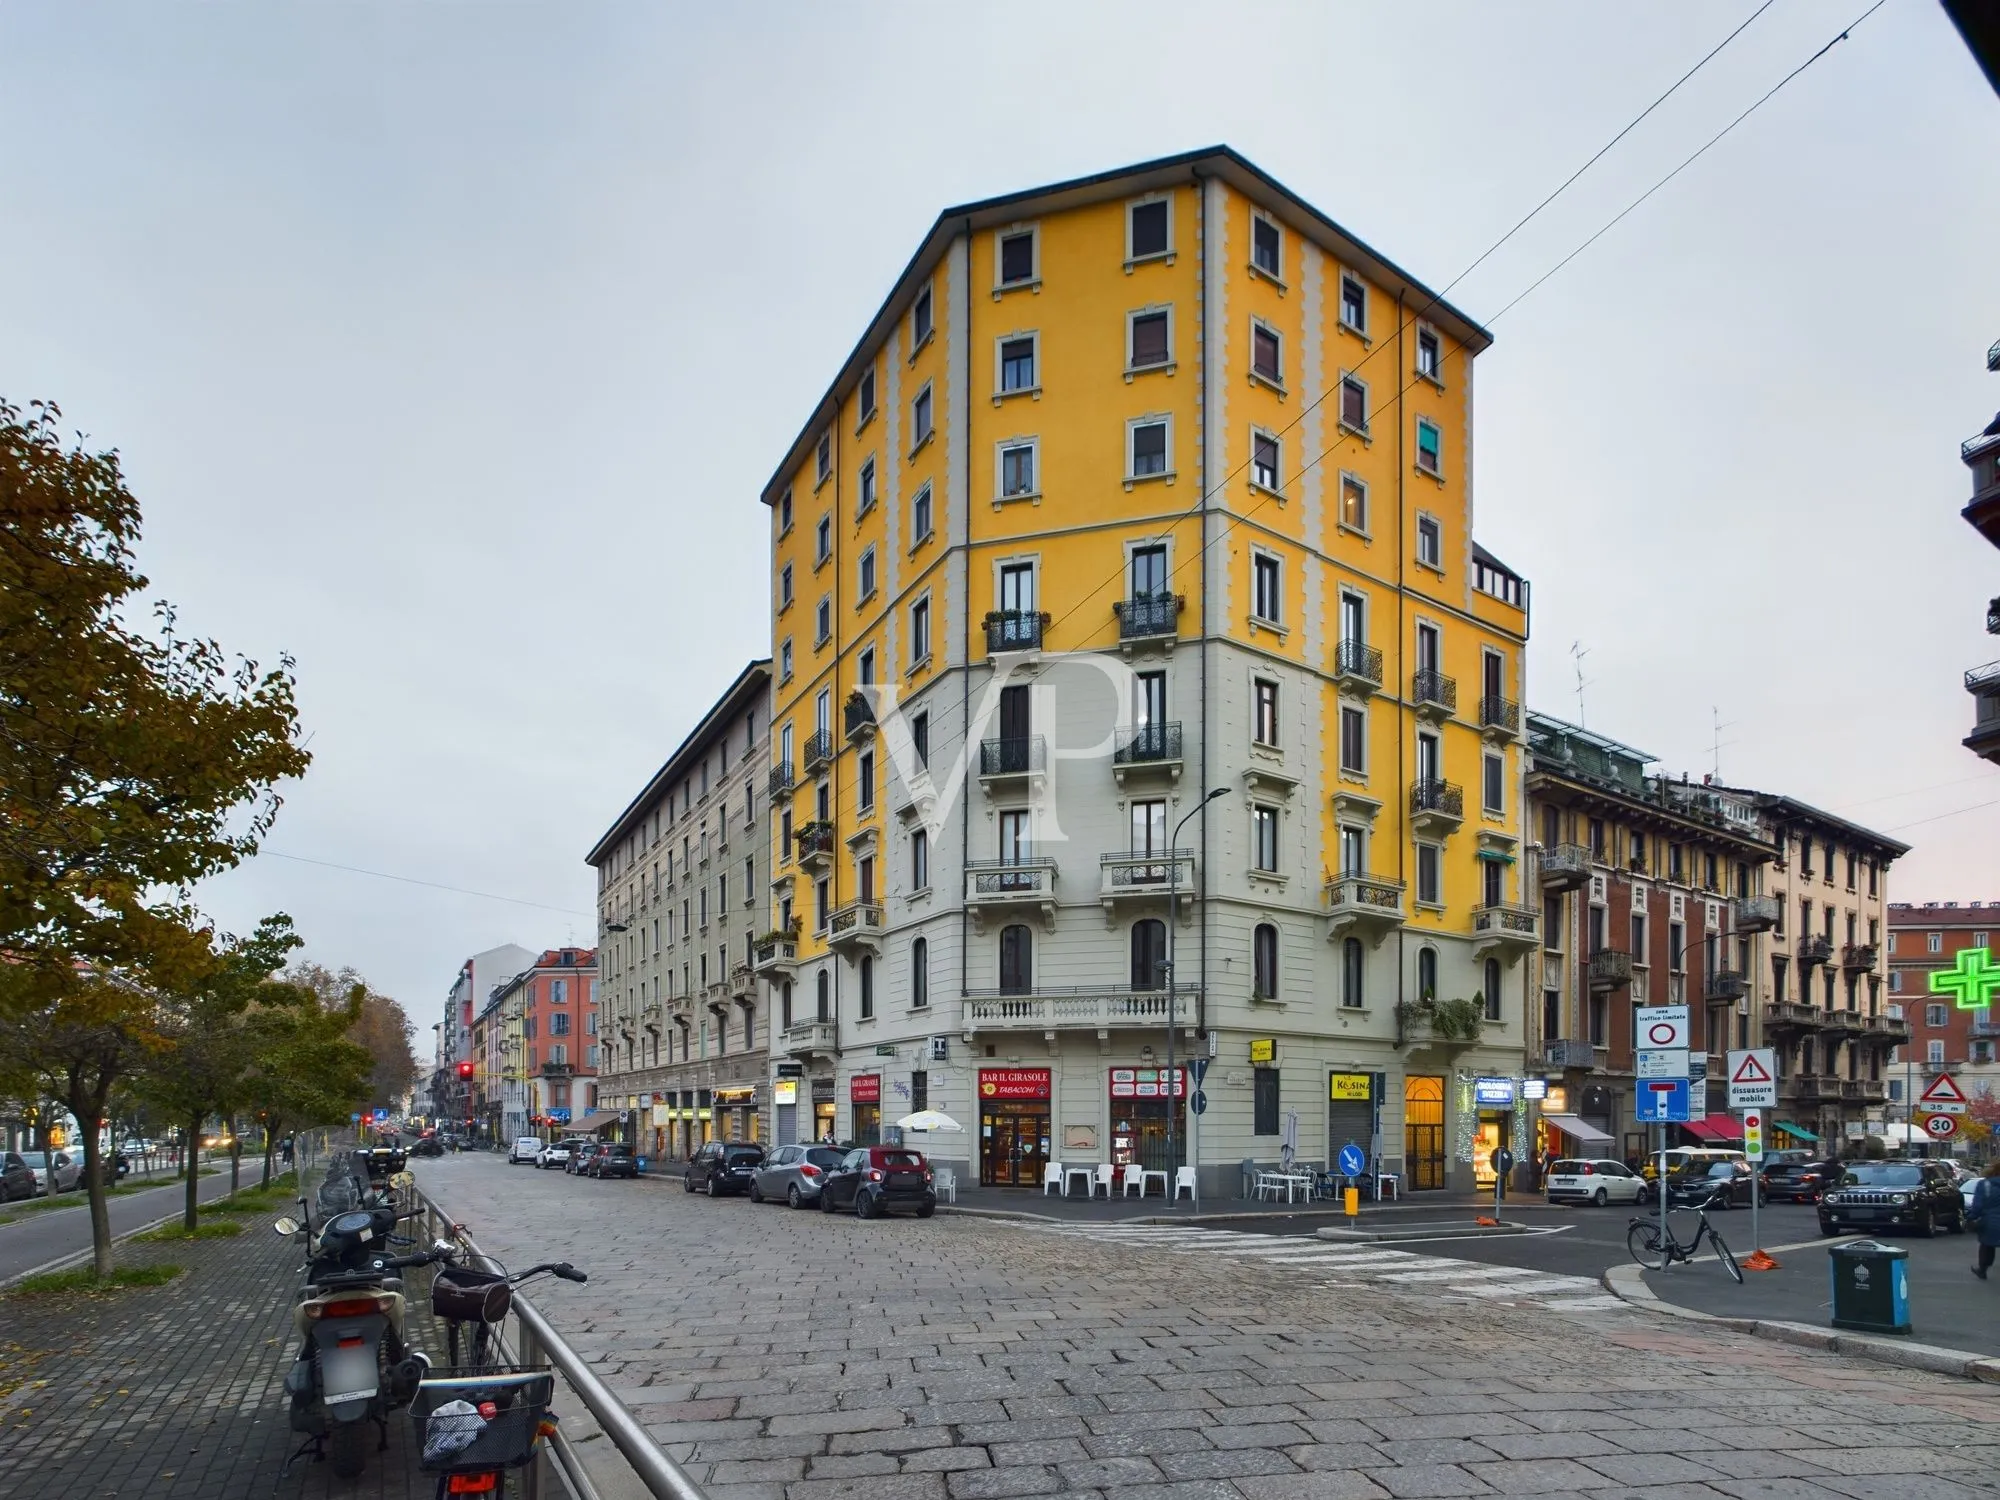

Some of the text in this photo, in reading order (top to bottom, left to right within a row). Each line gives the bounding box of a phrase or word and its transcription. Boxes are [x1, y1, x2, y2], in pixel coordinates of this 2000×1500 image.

[982, 1073, 1048, 1082] BAR IL GIRASOLE
[1931, 1119, 1950, 1131] 30
